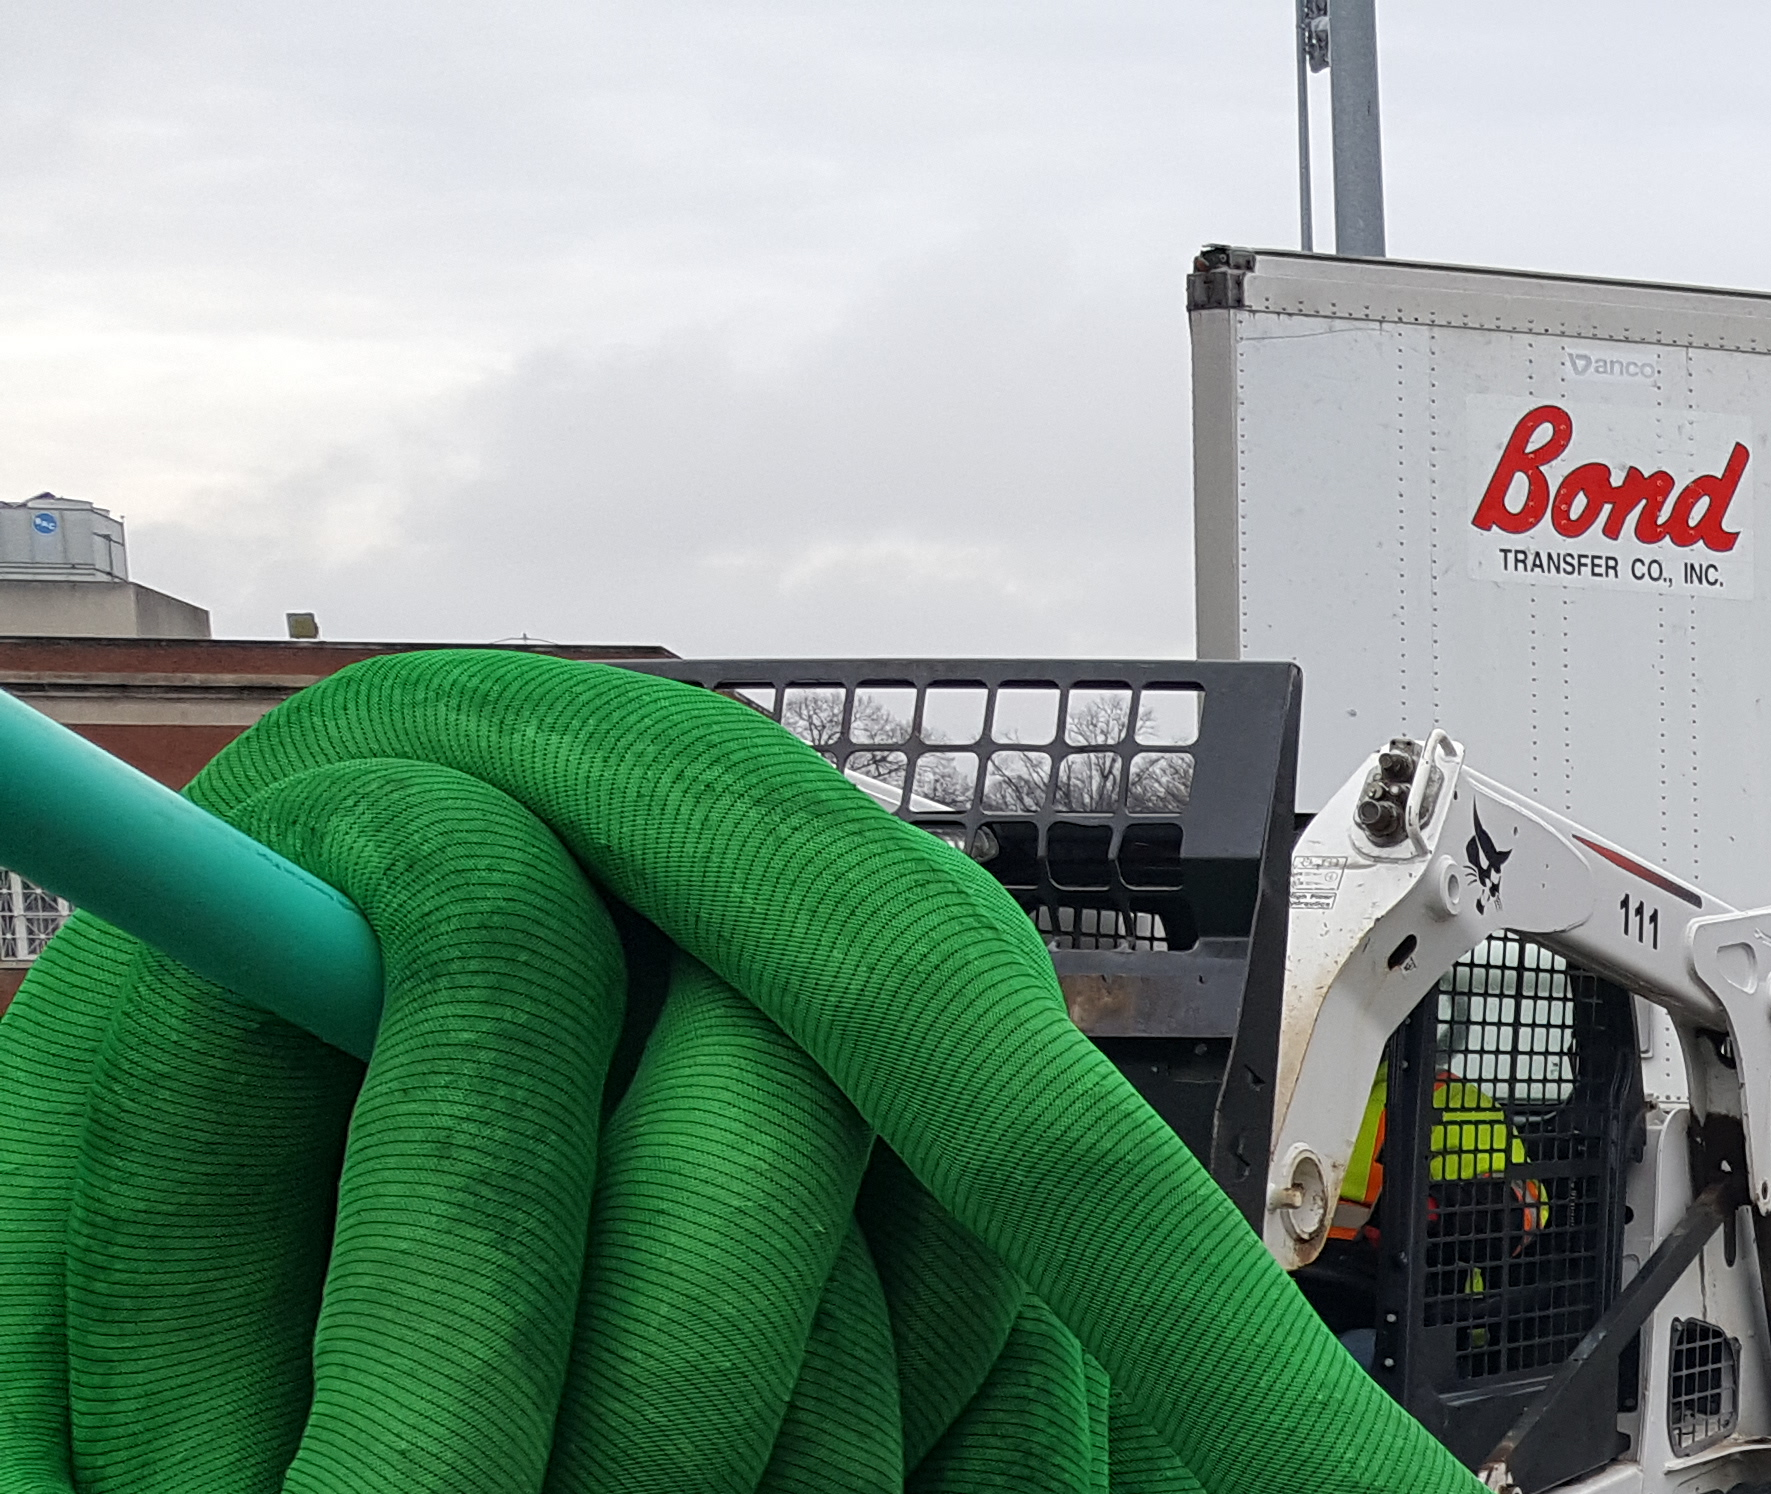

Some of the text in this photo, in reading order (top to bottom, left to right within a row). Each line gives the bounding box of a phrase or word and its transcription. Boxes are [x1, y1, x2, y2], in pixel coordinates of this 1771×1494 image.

[1471, 404, 1750, 552] Bond
[1499, 548, 1724, 588] TRANSFER CO., INC.
[1620, 893, 1658, 951] 111
